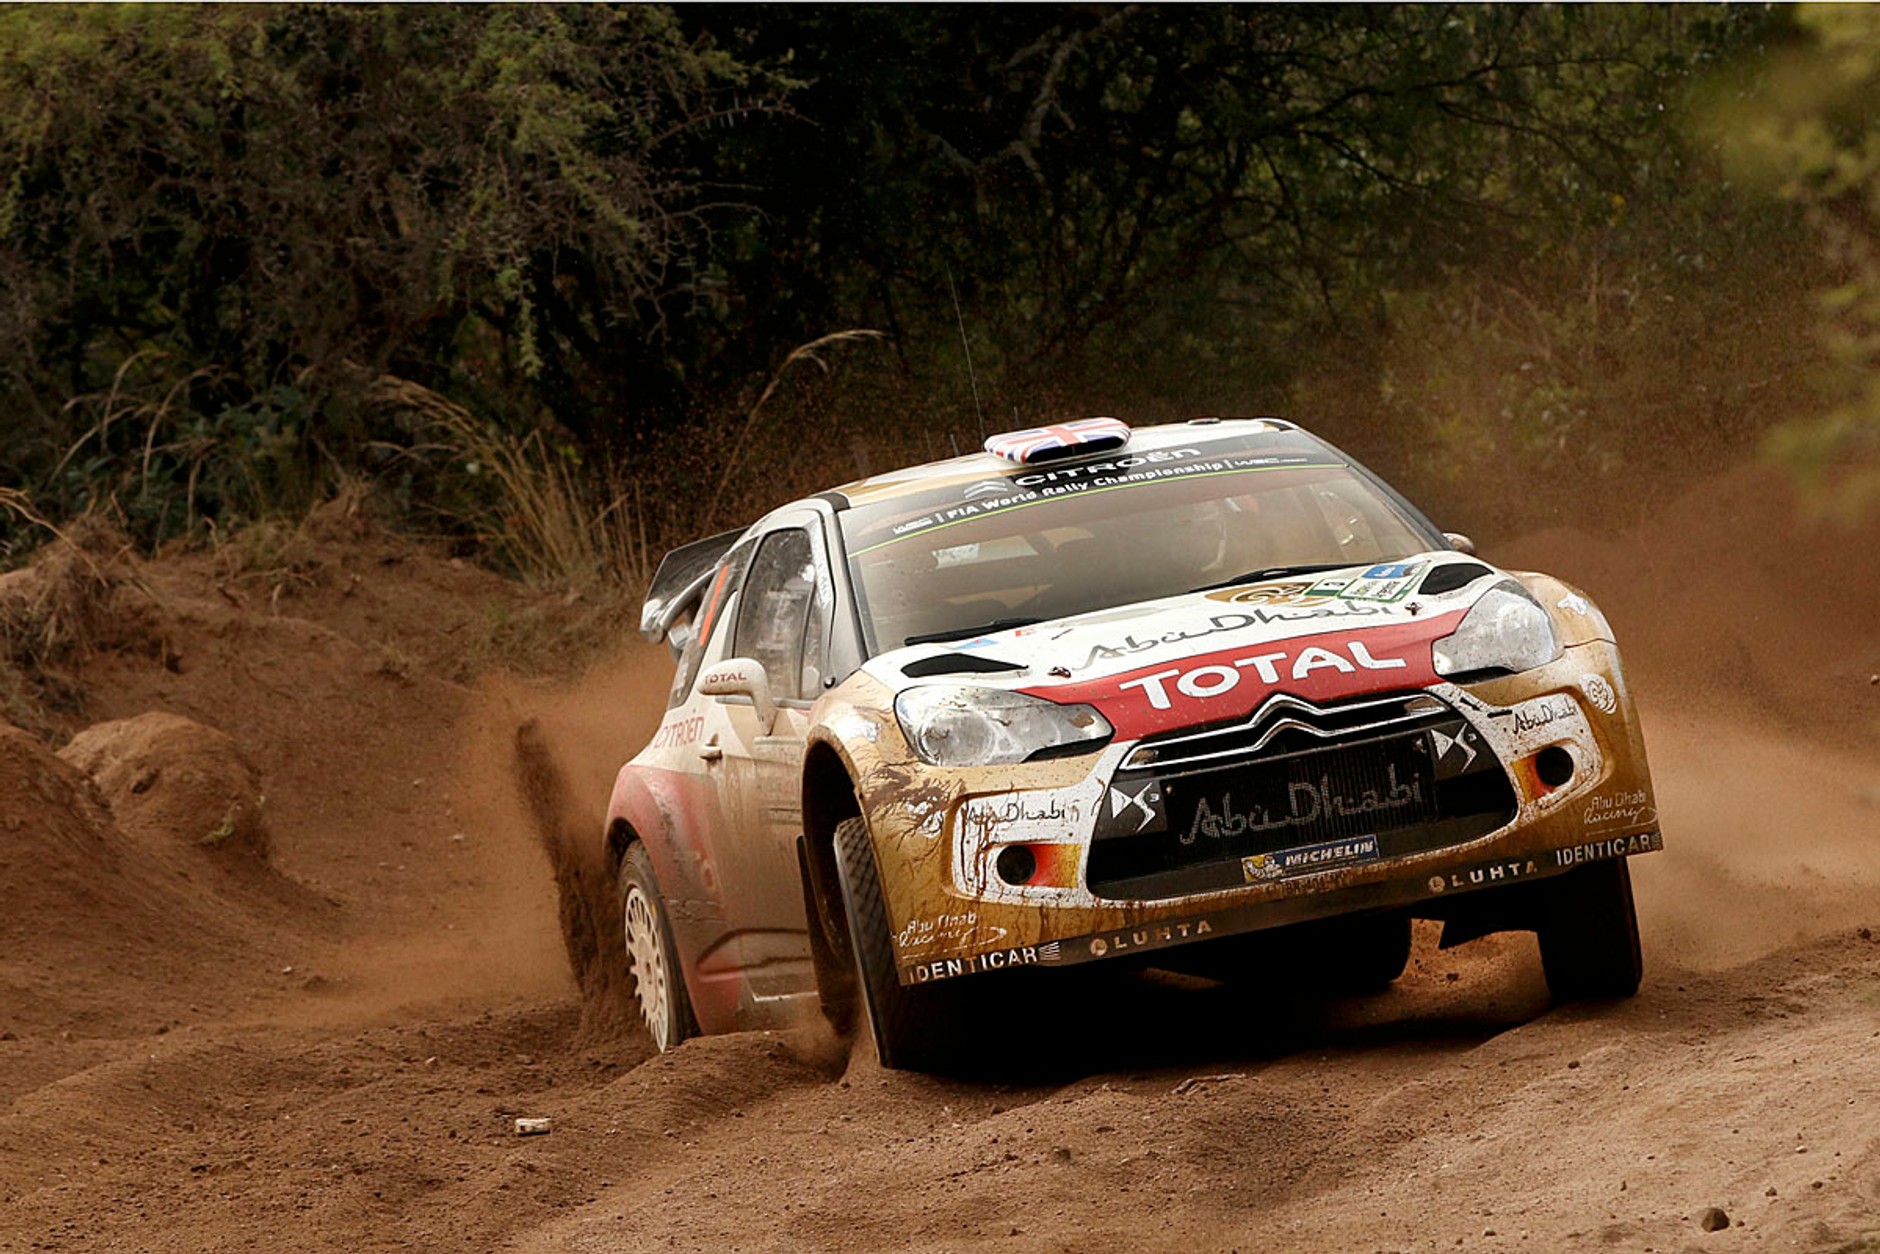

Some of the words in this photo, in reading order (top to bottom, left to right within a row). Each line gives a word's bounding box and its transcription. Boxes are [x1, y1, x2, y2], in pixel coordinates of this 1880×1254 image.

[946, 504, 980, 520] FIA
[981, 491, 1038, 511] World
[1041, 481, 1089, 498] Rally
[1093, 460, 1224, 487] Championship
[1072, 631, 1188, 671] Abu
[1206, 600, 1395, 632] Dhabi
[704, 672, 748, 685] TOTAL
[1119, 640, 1407, 710] TOTAL
[1004, 796, 1066, 823] Dhabi
[1180, 792, 1271, 845] Abu
[1287, 763, 1422, 825] Dhabi
[1592, 795, 1613, 810] Abu
[1285, 841, 1374, 866] MICHELIN
[1555, 833, 1651, 867] IDENTICAR
[1450, 860, 1538, 888] LUHTA
[1113, 919, 1213, 949] LUHTA
[908, 945, 1038, 984] IDENTICAR
